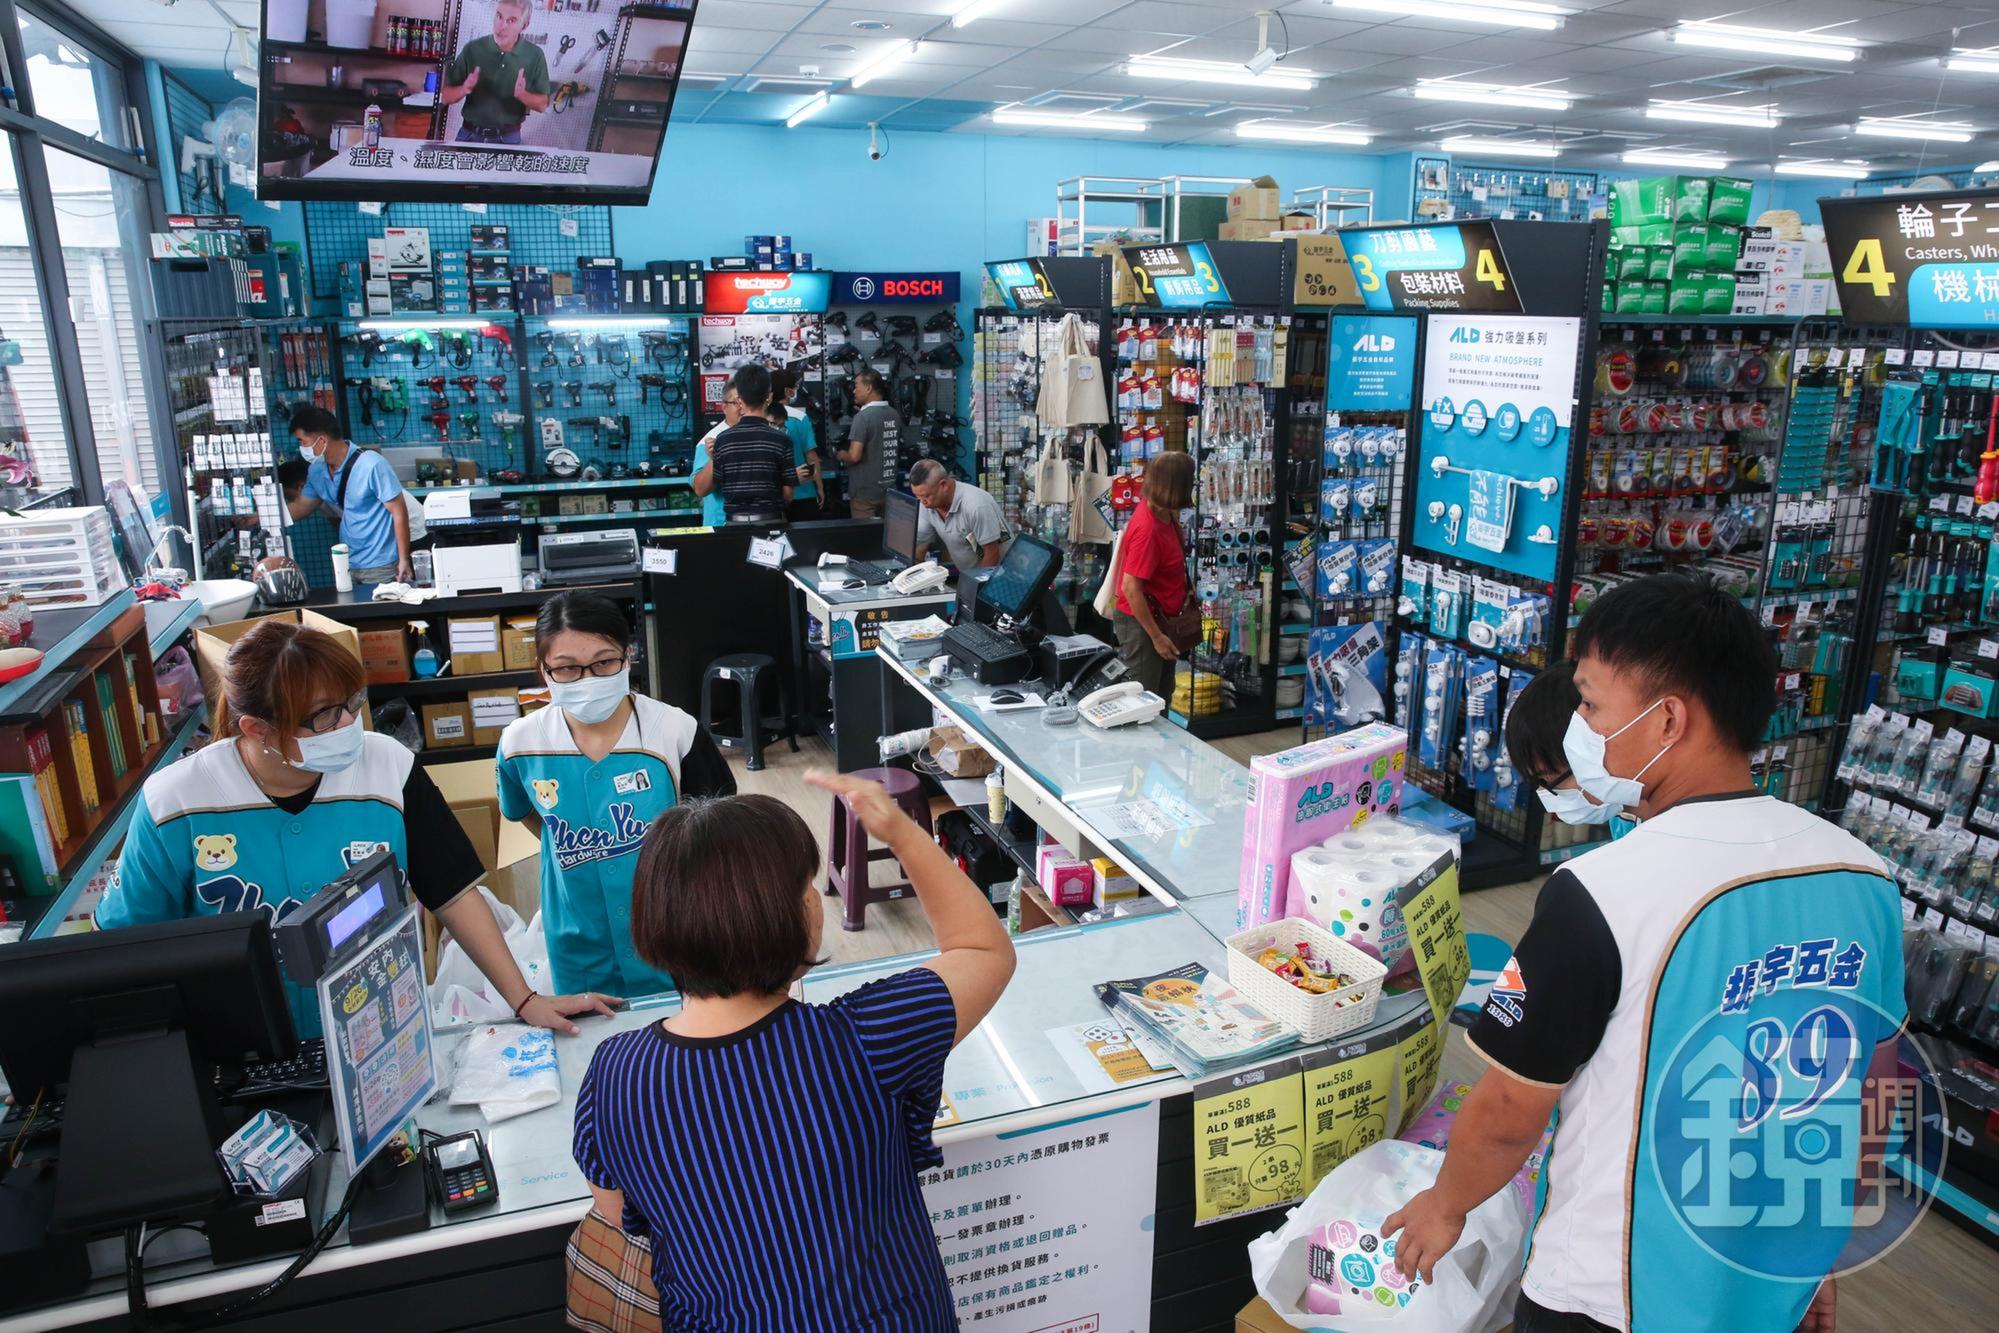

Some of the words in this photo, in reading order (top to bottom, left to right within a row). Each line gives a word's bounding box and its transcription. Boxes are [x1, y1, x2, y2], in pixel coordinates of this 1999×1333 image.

[1751, 231, 1771, 239] Scotch
[1905, 246, 1968, 261] Casters,
[1197, 262, 1219, 292] 3
[1352, 254, 1380, 292] 3
[1476, 249, 1505, 290] 4
[1843, 238, 1896, 297] 4
[734, 278, 787, 290] techway
[884, 280, 942, 296] BOSCH
[1035, 273, 1054, 297] 2
[1133, 266, 1155, 294] 2
[1401, 272, 1464, 294] 包裝材料
[1403, 299, 1430, 309] Packing
[1430, 300, 1460, 308] Supplies
[1353, 334, 1395, 351] ALD
[1450, 327, 1480, 343] ALD
[1485, 331, 1547, 346] 強力吸盤系列
[1449, 353, 1472, 362] BRAND
[1475, 354, 1491, 363] NEW
[1494, 355, 1543, 366] ATMOSPHERE
[1297, 781, 1334, 808] ALD
[558, 849, 609, 869] Hardware
[1416, 922, 1429, 938] ALD
[1421, 912, 1460, 963] 買一送一
[1720, 937, 1866, 1016] 振宇五金
[1405, 1061, 1417, 1076] ALD
[1737, 1004, 1857, 1134] 89
[1316, 1094, 1334, 1108] ALD
[1206, 1122, 1228, 1134] ALD
[1234, 1108, 1276, 1129] 優質紙品
[1316, 1095, 1386, 1135] 買一送一
[1208, 1123, 1298, 1160] 買一送一
[1361, 1129, 1375, 1149] 98
[1921, 1113, 1975, 1147] ALD
[521, 1171, 568, 1186] Service
[1268, 1159, 1289, 1179] 98
[929, 1195, 1022, 1223] 卡及簽單辦理。
[943, 1223, 1087, 1266] 則取消資格或退回贈品。
[953, 1264, 1099, 1308] 店保有商品鑑定之權利。
